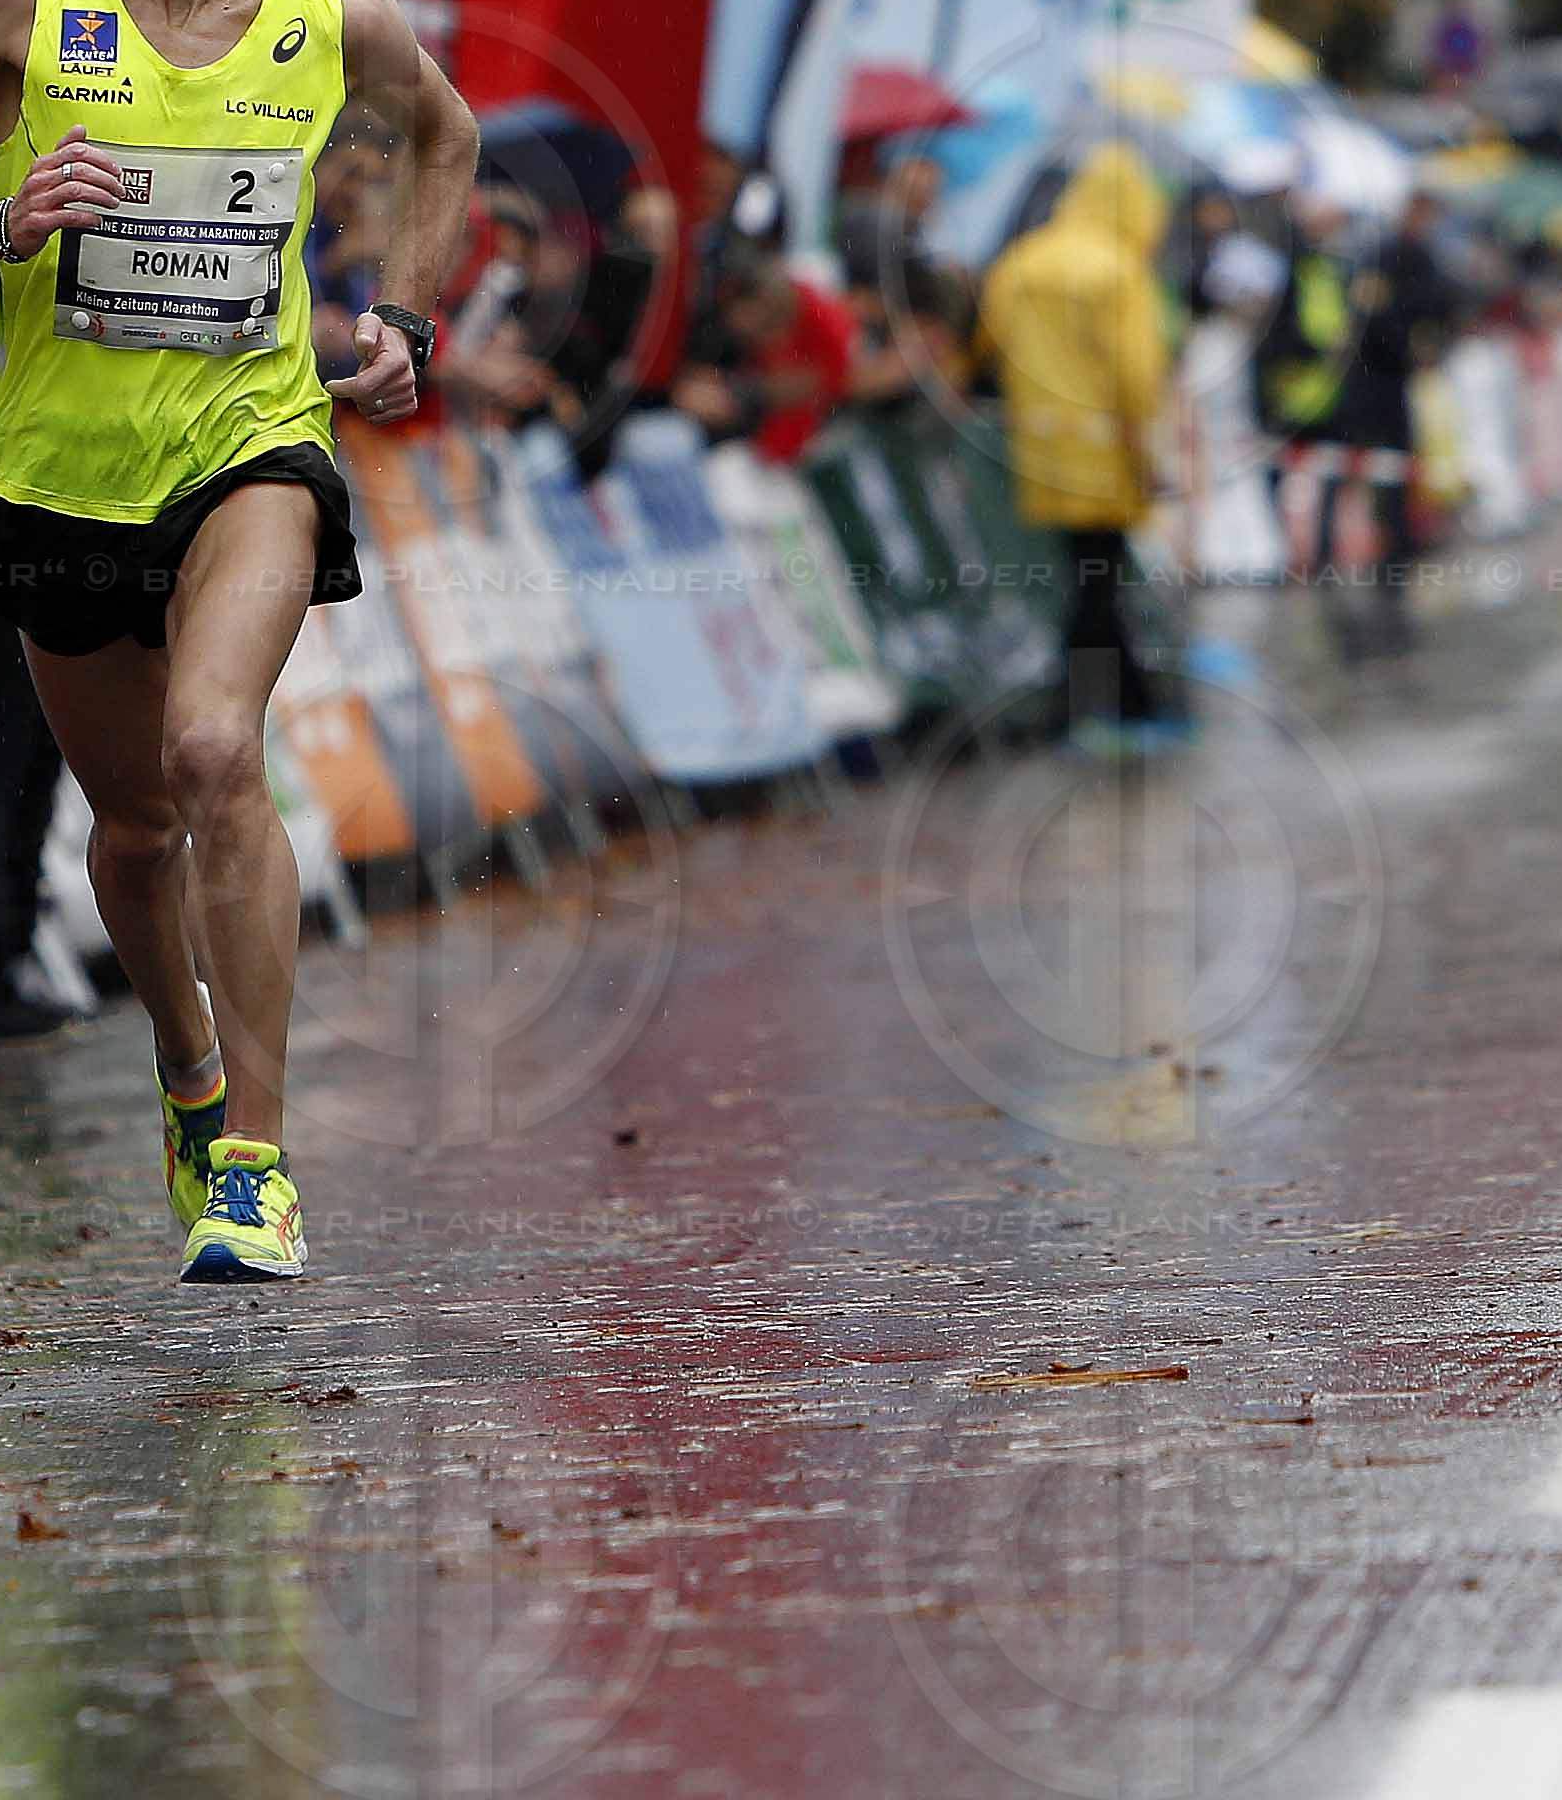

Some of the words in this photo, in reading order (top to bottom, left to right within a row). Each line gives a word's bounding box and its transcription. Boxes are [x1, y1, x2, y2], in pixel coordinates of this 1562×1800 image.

[45, 84, 134, 105] GARMIN
[226, 99, 247, 114] LC
[252, 102, 315, 123] VILLACH
[225, 169, 257, 213] 2
[120, 222, 166, 237] ZEITUNG
[168, 226, 197, 239] GRAZ
[199, 227, 257, 241] MARATHON
[258, 228, 280, 241] 2015
[131, 250, 230, 281] ROMAN
[76, 291, 110, 309] Kleine
[113, 297, 159, 314] Zeitung
[162, 301, 220, 318] Marathon
